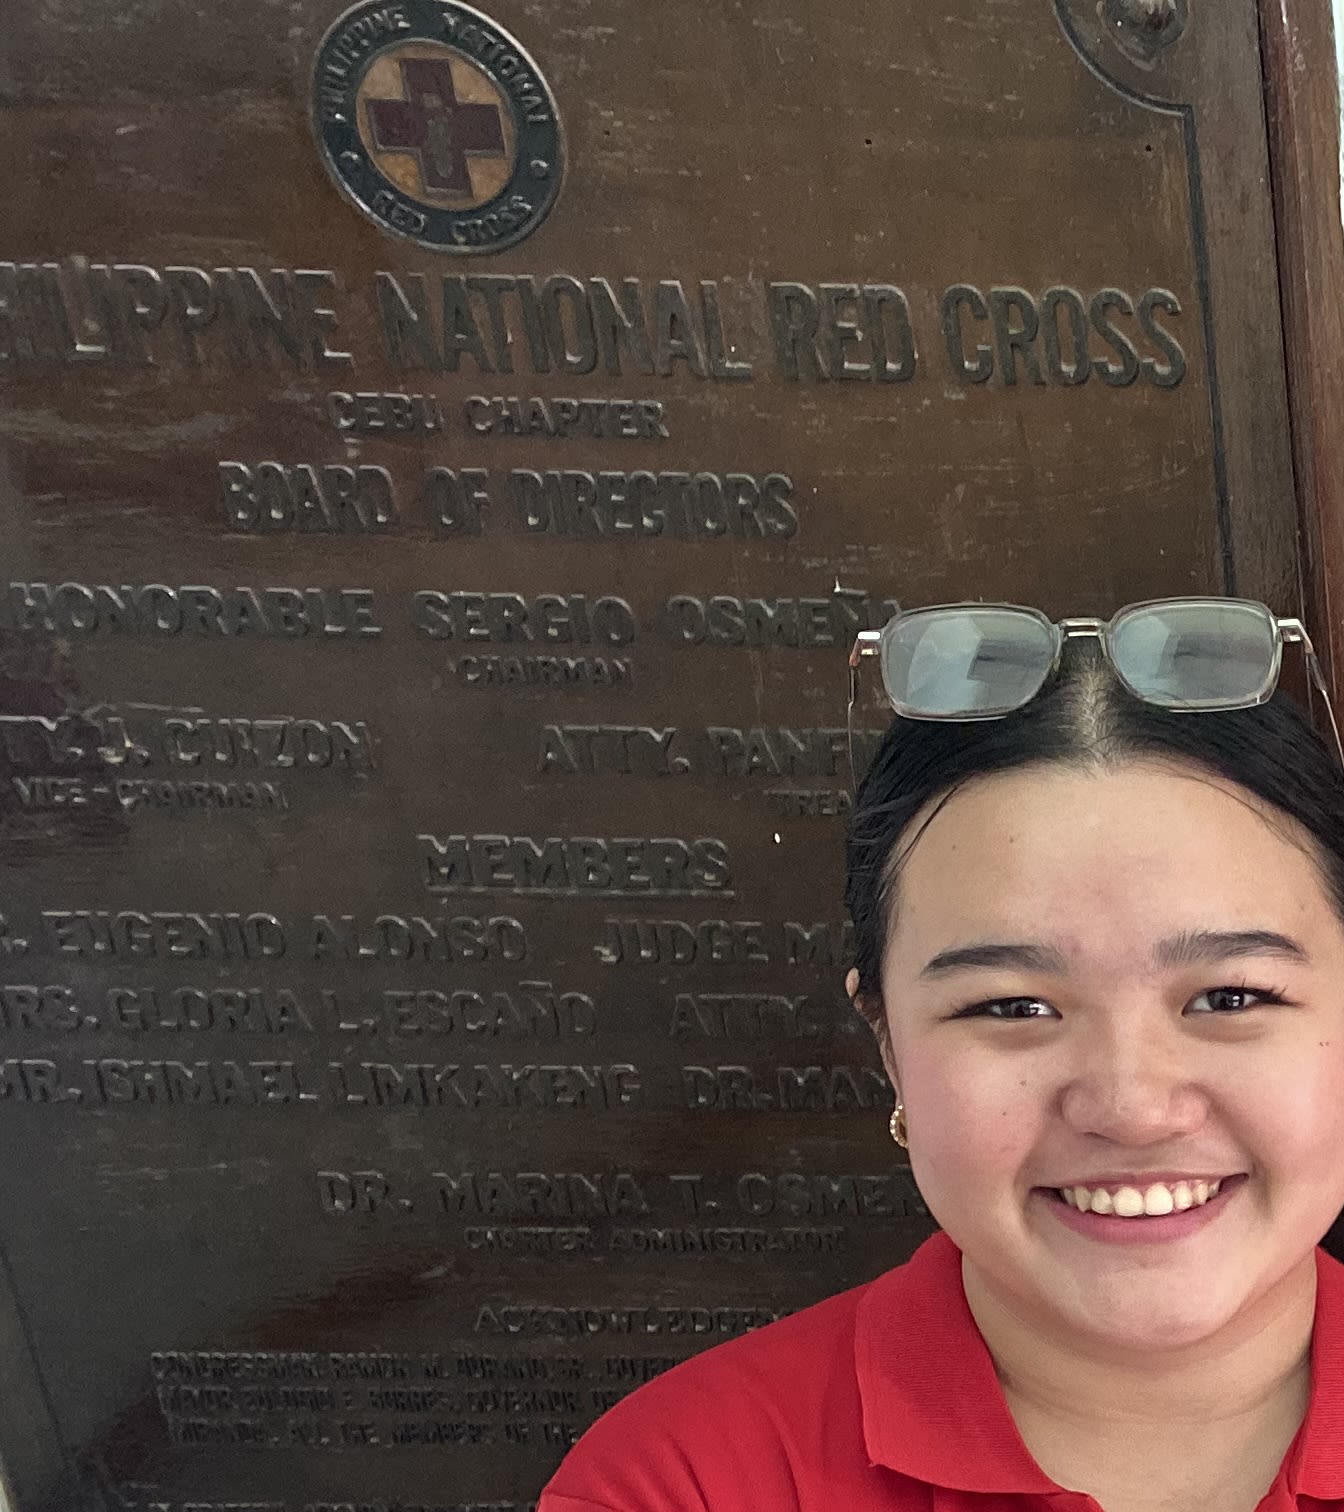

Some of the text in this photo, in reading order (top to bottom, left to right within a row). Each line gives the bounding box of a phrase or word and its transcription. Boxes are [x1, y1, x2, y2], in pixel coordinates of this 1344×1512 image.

[375, 270, 754, 378] NATIONAL
[768, 282, 918, 384] RED
[943, 283, 1188, 387] CROSS
[330, 392, 671, 438] CEBU CHAPTER
[218, 461, 798, 537] BOARD OF DIRECTORS
[7, 583, 384, 638] HONORABLE
[413, 590, 637, 646] SERGIO
[459, 654, 632, 690] CHAIRMAN
[164, 718, 378, 768] CUIZON
[538, 723, 692, 776] ATTY.
[416, 834, 735, 890] MEMBERS
[42, 910, 286, 960] EUGENIO
[312, 913, 528, 962] ALONSO
[595, 917, 768, 965] JUDGE
[0, 984, 100, 1032] RS.
[106, 986, 314, 1034] GLORIA
[82, 1060, 320, 1105] ISHMAEL
[316, 1171, 413, 1214] DR.
[431, 1172, 650, 1217] MARINA
